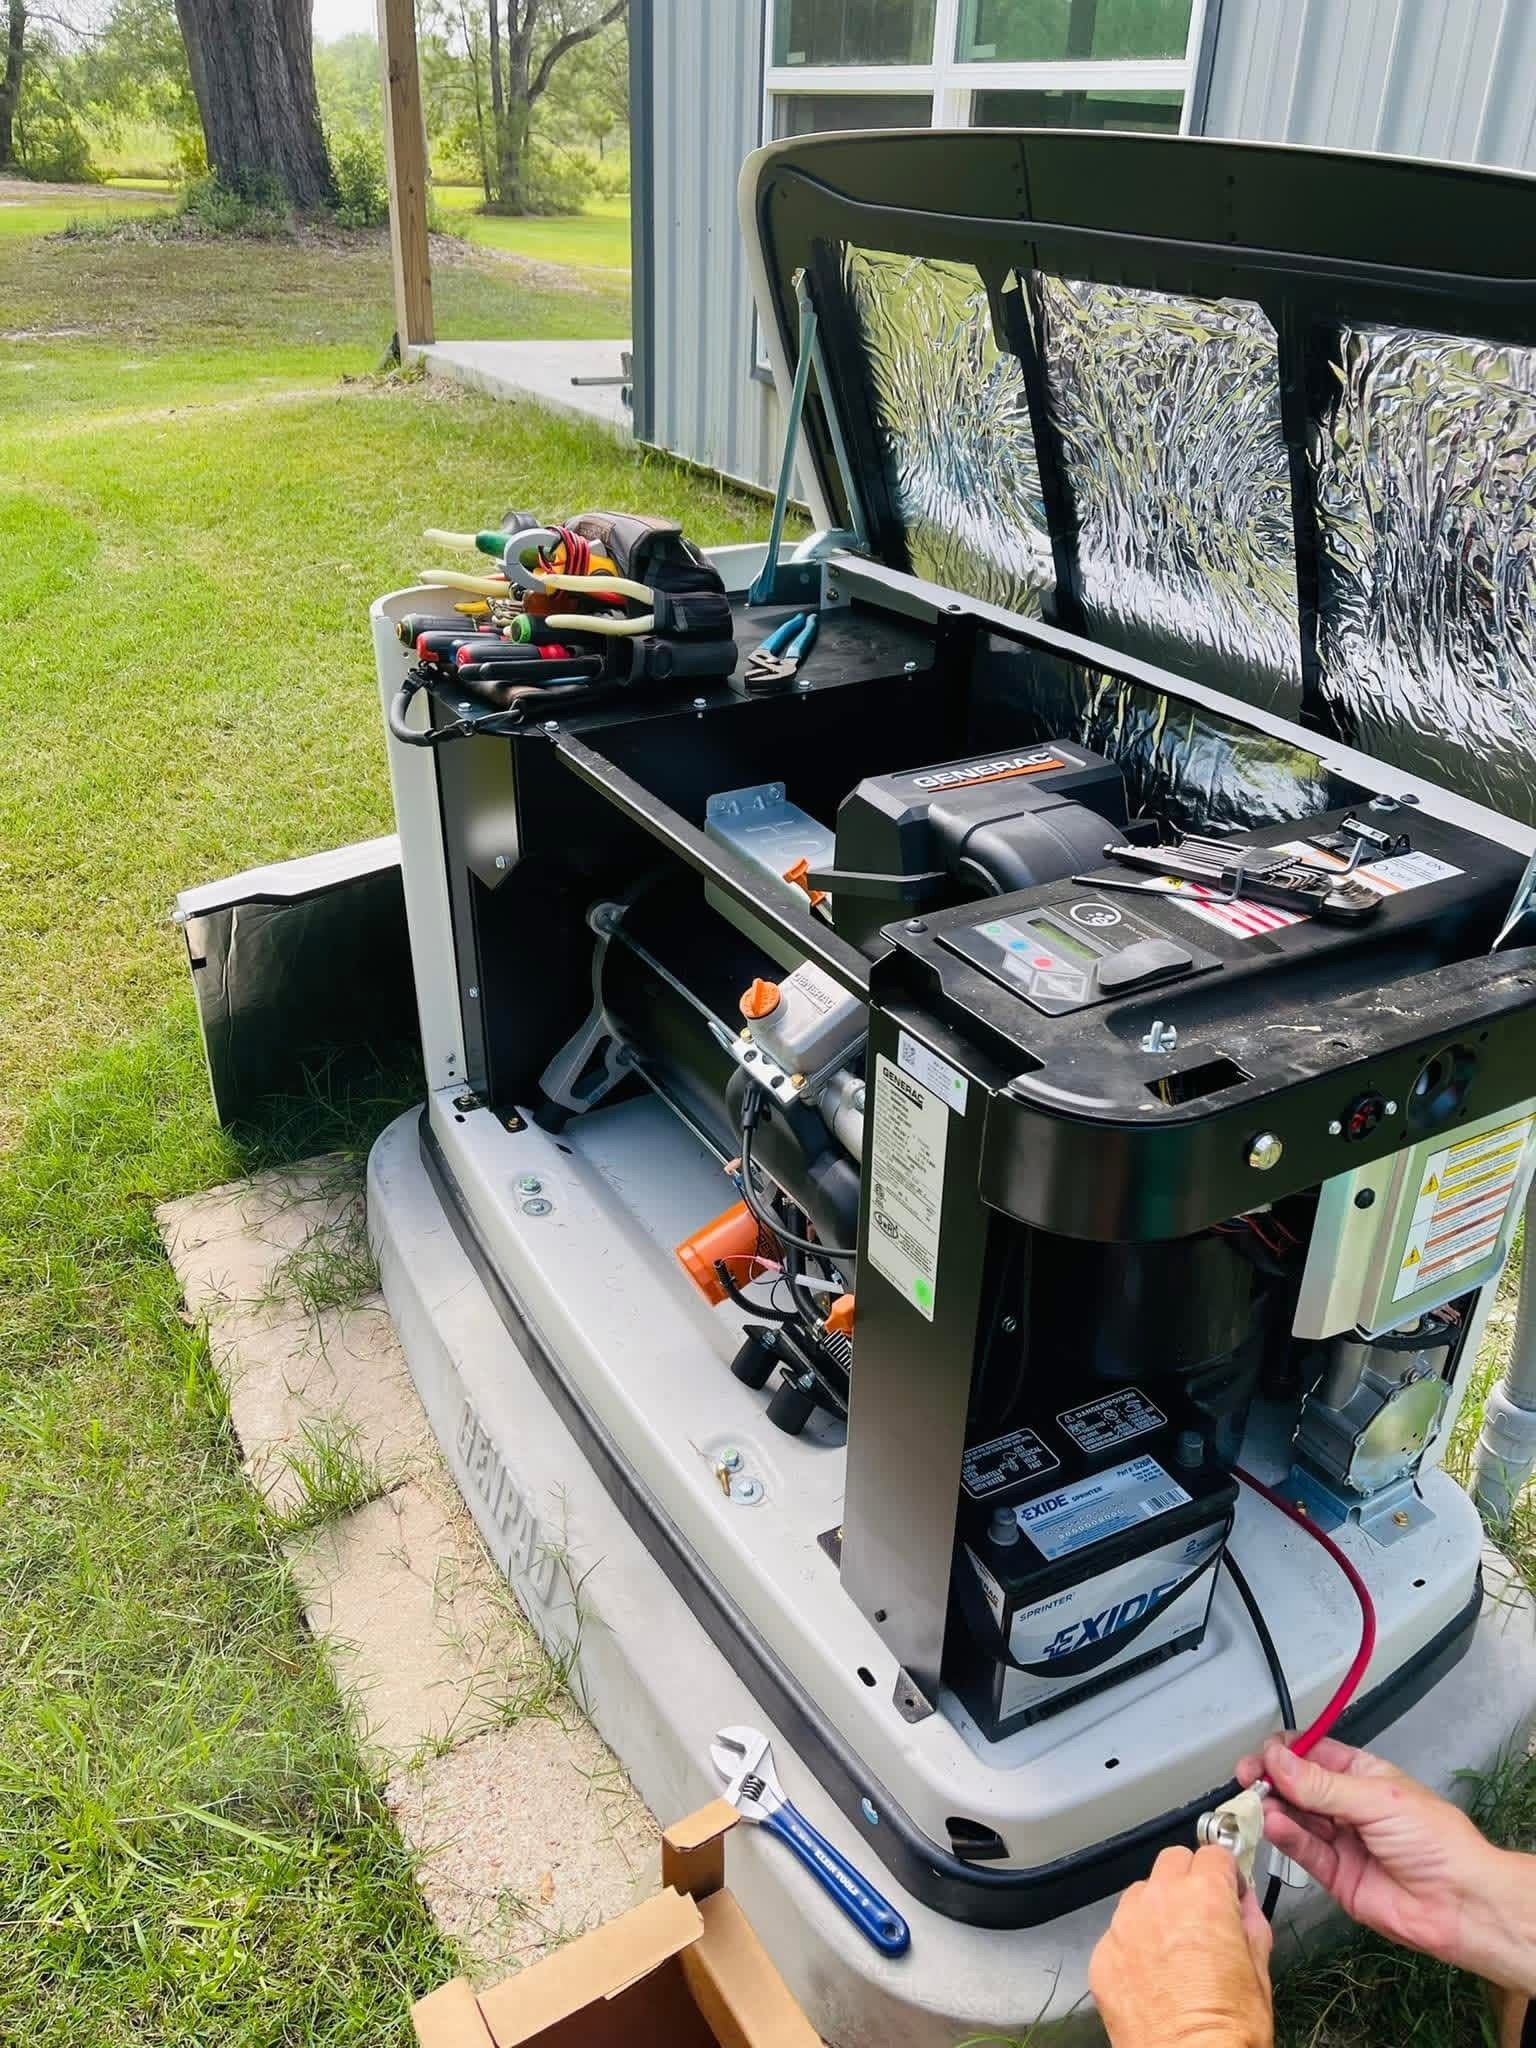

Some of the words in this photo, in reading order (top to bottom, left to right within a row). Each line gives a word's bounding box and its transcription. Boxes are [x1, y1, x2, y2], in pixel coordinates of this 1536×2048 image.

[913, 752, 1053, 787] GENERAC
[792, 974, 836, 1009] GENERAC
[882, 1067, 925, 1104] GENERAC
[1021, 1493, 1070, 1521] EXIDE
[1071, 1486, 1104, 1502] SPRINTER
[1019, 1593, 1073, 1622] SPRINTER
